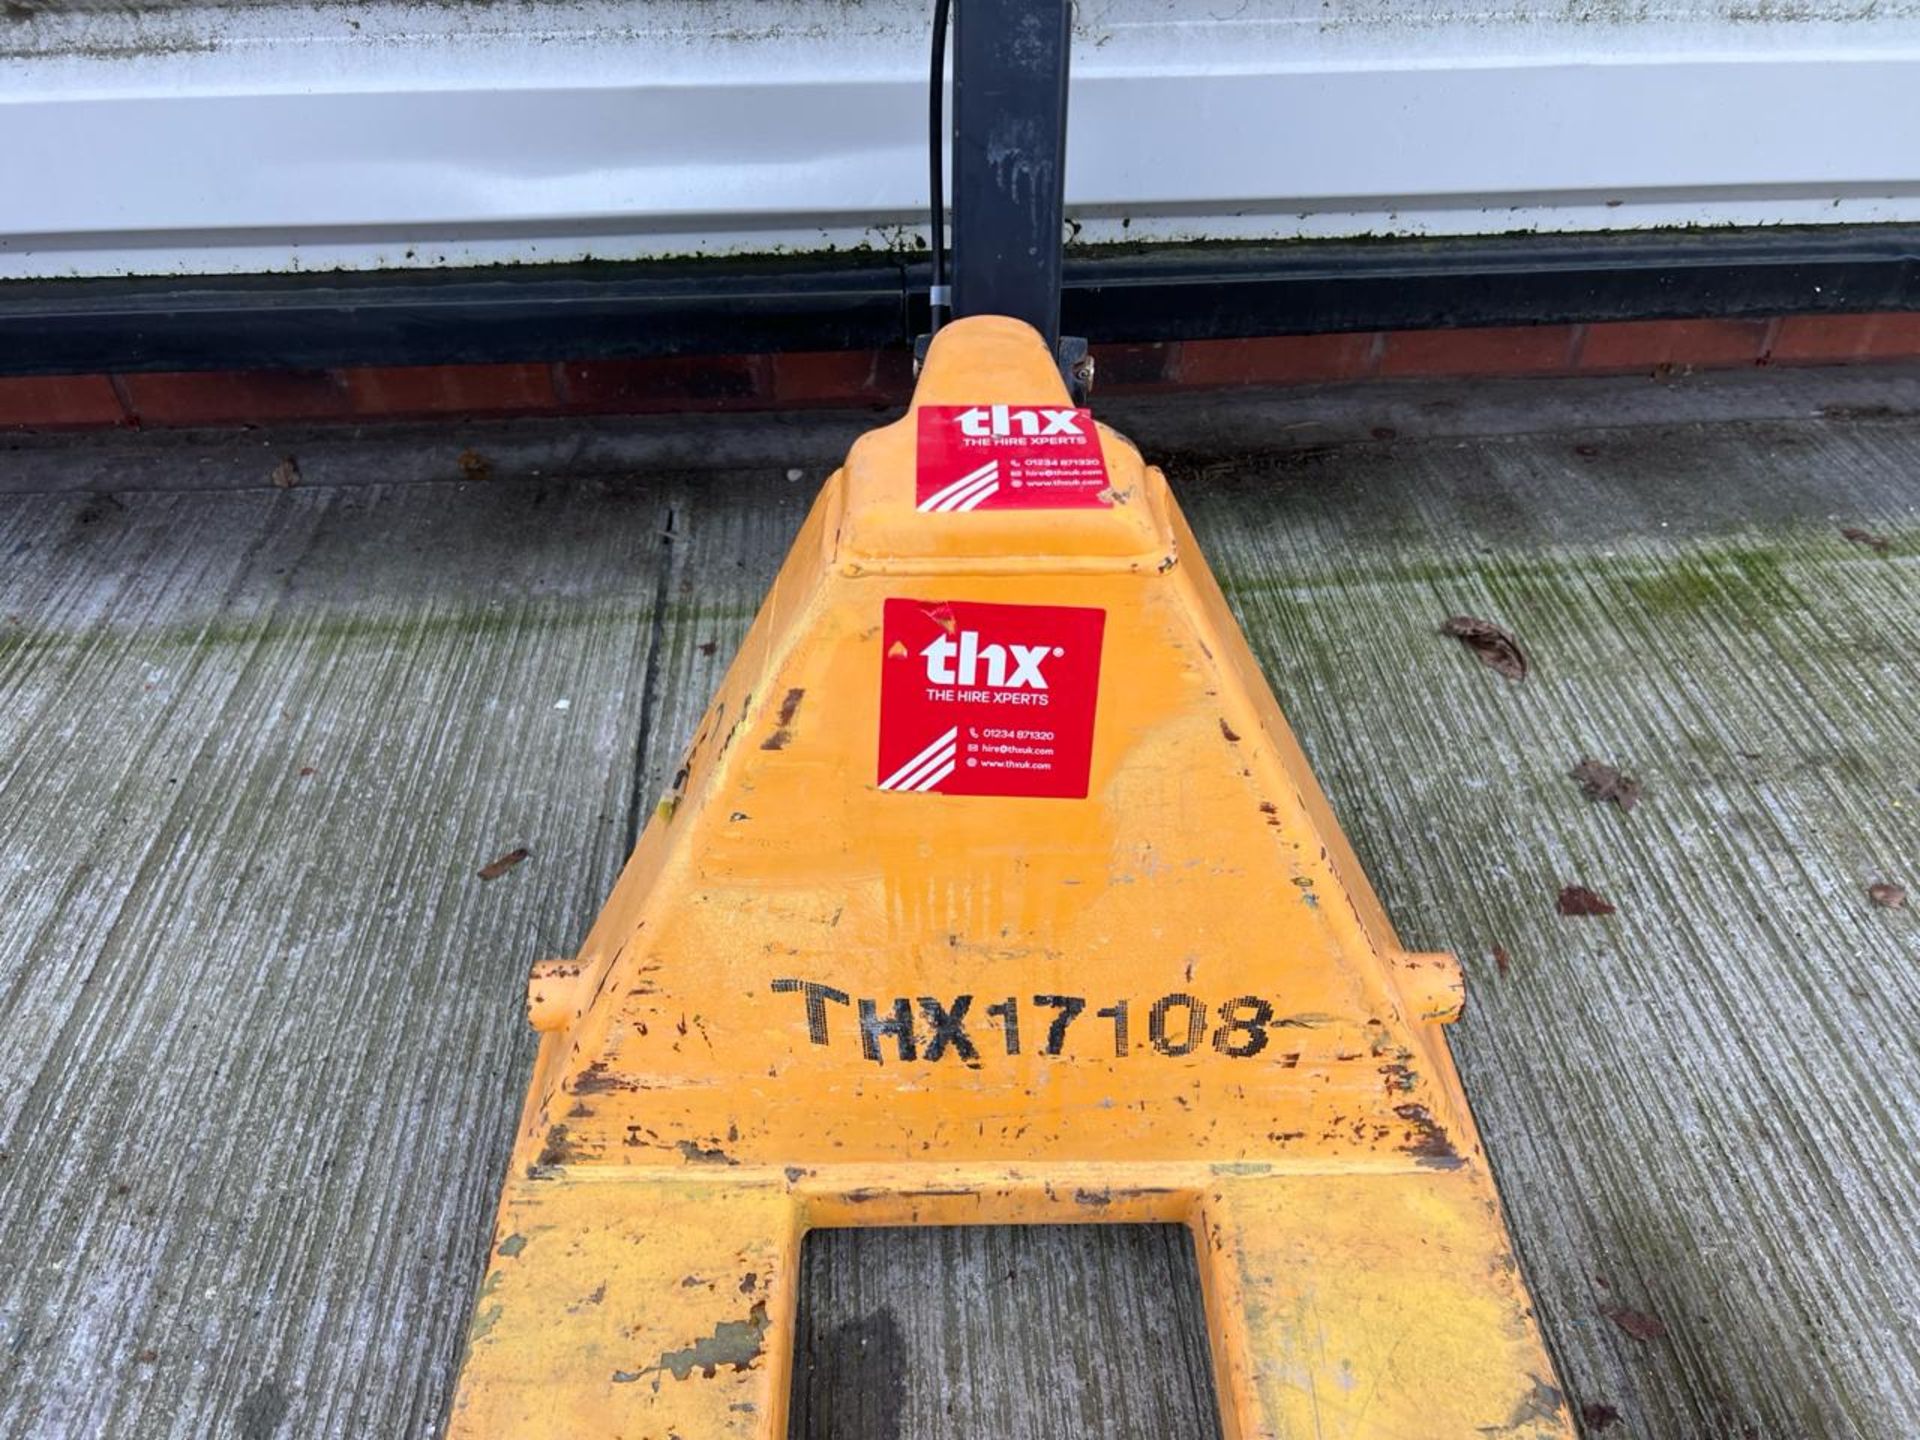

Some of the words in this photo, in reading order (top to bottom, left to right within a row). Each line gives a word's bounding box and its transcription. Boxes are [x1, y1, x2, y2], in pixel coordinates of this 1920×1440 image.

[953, 405, 1085, 436] thx
[963, 438, 992, 446] THE
[994, 437, 1027, 446] HIRE
[1031, 436, 1087, 446] XPERTS
[919, 630, 1052, 689] thx
[926, 689, 955, 702] THE
[957, 690, 990, 704] HIRE
[993, 692, 1049, 706] XPERTS
[983, 728, 1015, 739] 01234
[1016, 729, 1055, 741] 871320
[982, 743, 1054, 756] hire@thxuk.com
[980, 759, 1052, 770] www.thxuk.com
[771, 978, 1273, 1067] THX17108
